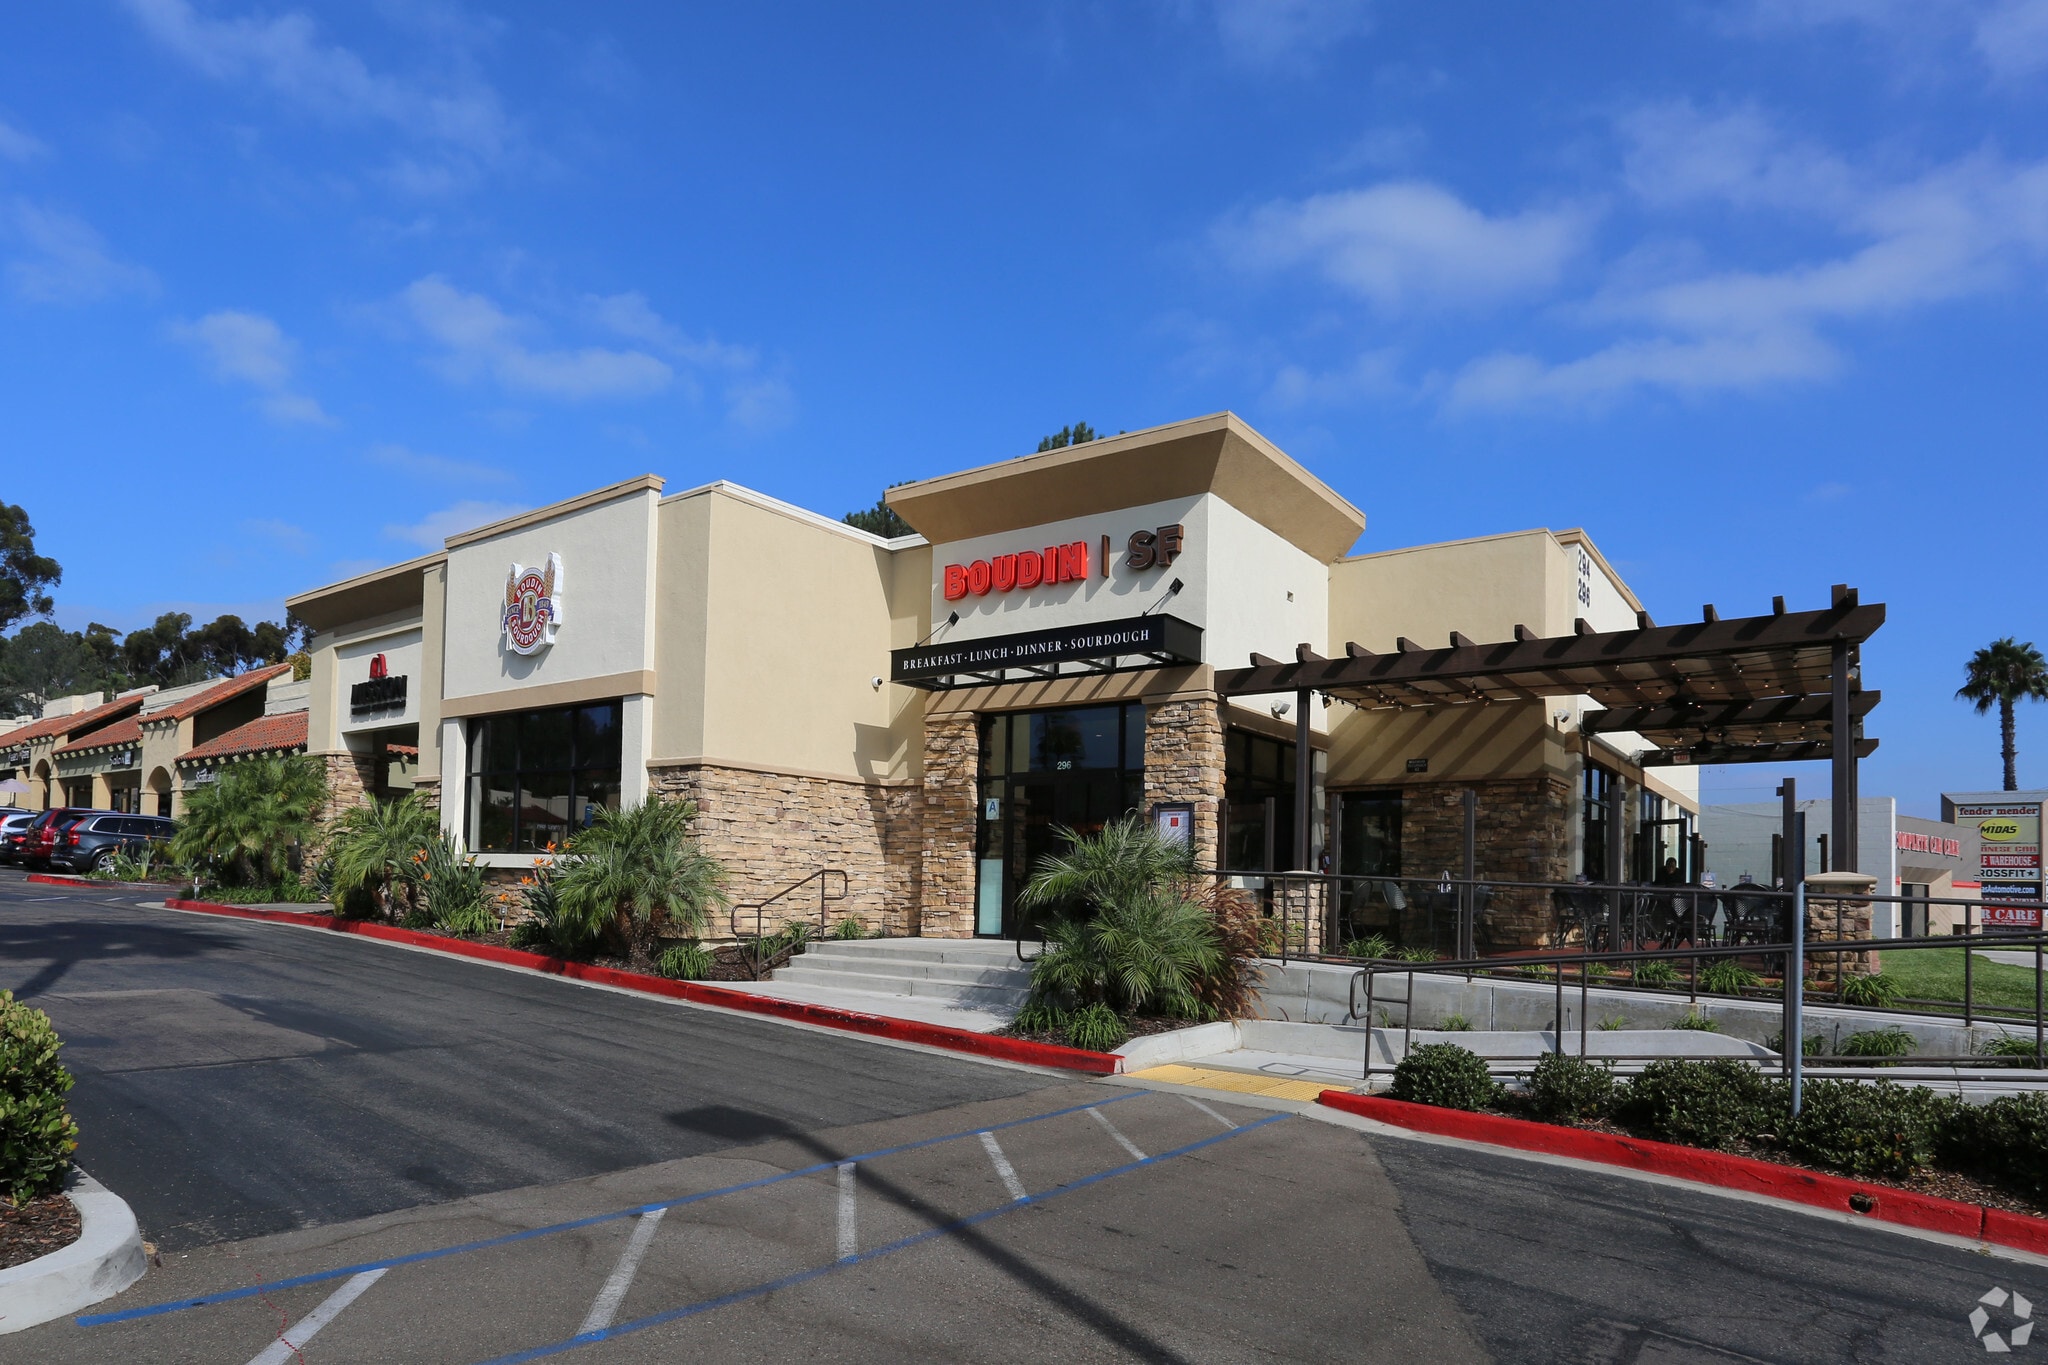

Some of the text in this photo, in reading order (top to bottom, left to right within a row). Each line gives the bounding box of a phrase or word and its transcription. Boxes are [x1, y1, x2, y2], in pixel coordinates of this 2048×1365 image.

[944, 523, 1185, 601] BOUDIN SF
[516, 578, 543, 598] BOUDIN
[511, 614, 545, 644] SOURDOUGH
[902, 629, 1150, 671] BREAKFAST LUNCH DINNER SOURDOUGH
[1057, 761, 1072, 770] 296
[989, 801, 997, 812] A
[1960, 806, 2038, 816] fender mender
[1980, 825, 2017, 834] MIDAS
[1990, 855, 2032, 866] WAREHOUSE
[1981, 869, 2026, 878] ROSSFIT
[1995, 909, 2037, 921] CARE
